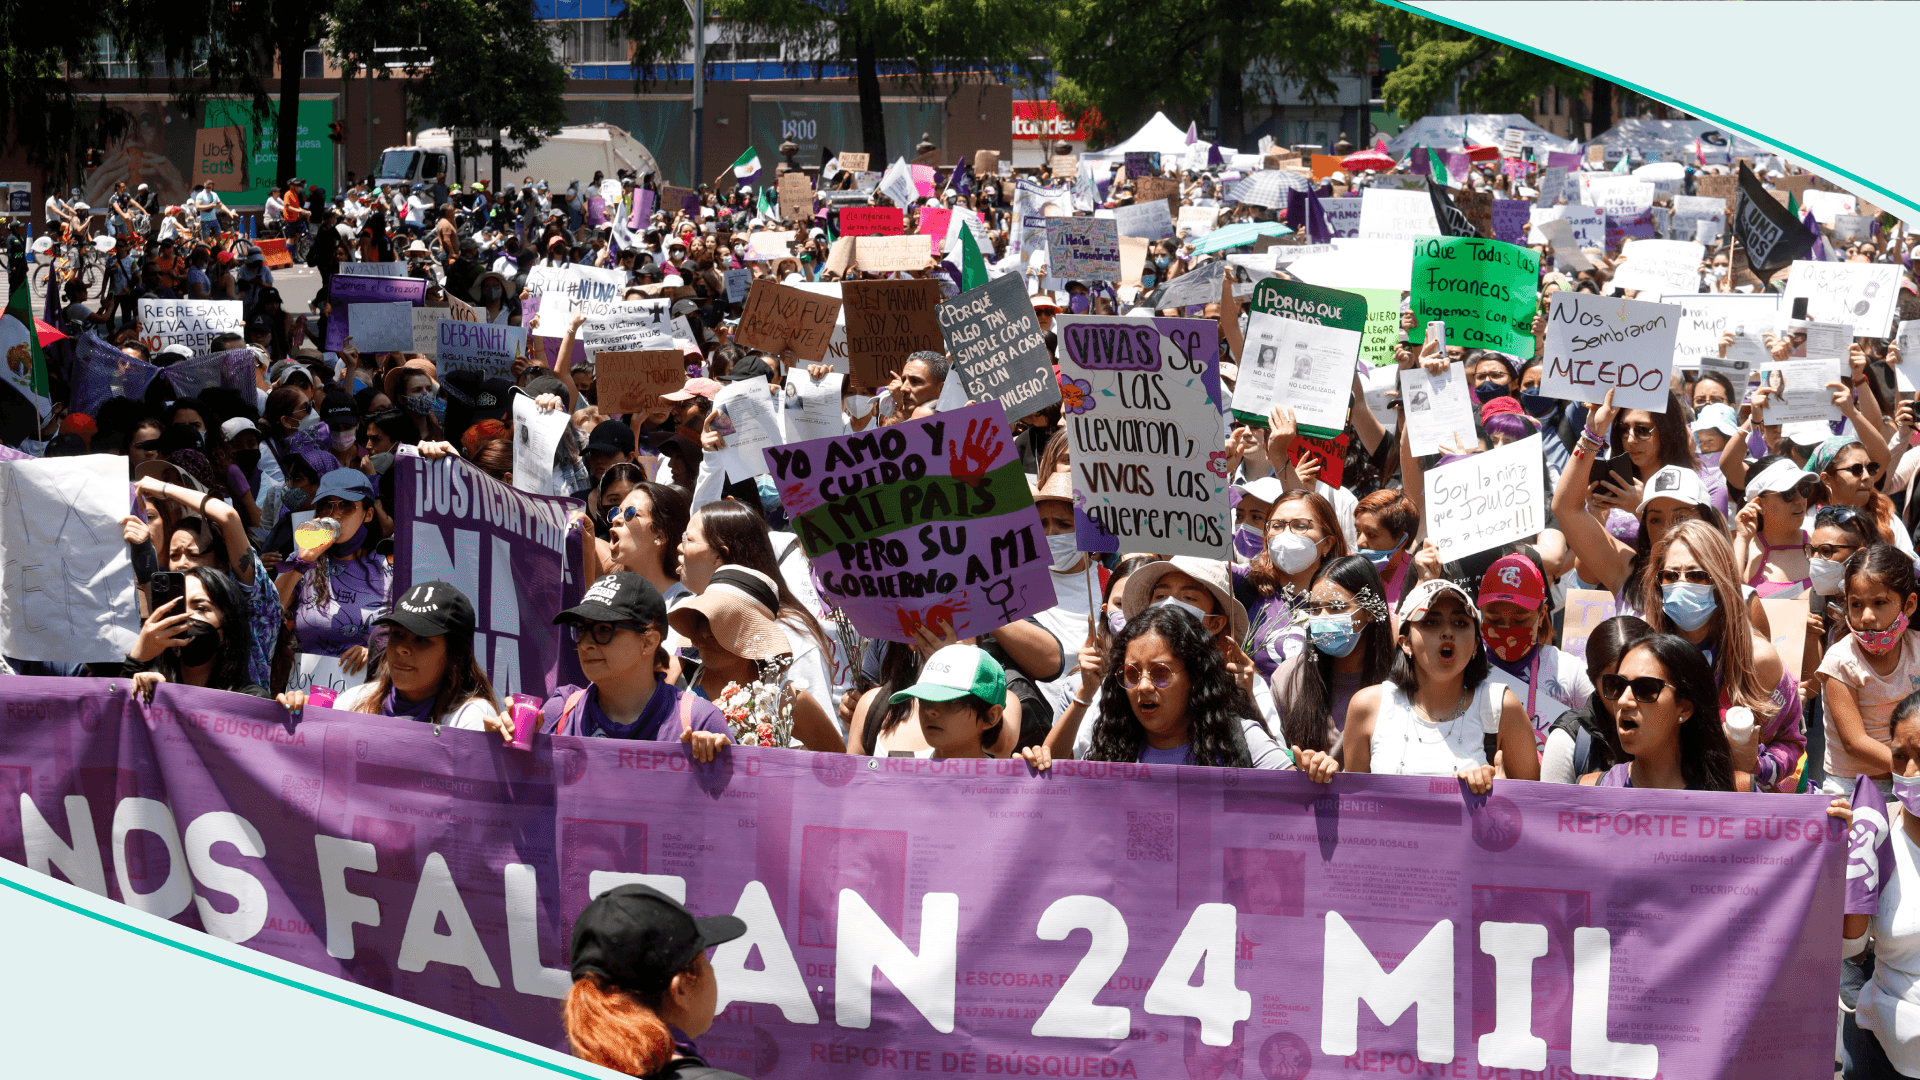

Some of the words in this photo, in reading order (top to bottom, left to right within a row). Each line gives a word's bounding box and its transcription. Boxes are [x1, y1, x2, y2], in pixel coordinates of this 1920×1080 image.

[463, 128, 490, 138] SEVILLA
[782, 119, 817, 140] 1800
[202, 142, 238, 157] Uber
[202, 159, 234, 175] Eats
[1465, 242, 1511, 266] Todas
[1427, 267, 1510, 302] Foraneas
[144, 304, 229, 319] REGRESAR
[569, 299, 610, 317] MENOS
[800, 301, 838, 325] FUE
[982, 308, 1007, 331] TAN
[1316, 303, 1344, 320] QUE
[1553, 298, 1604, 328] Nos
[143, 320, 188, 334] VIVA
[192, 320, 203, 332] A
[204, 318, 243, 333] CASA
[745, 314, 826, 352] ACCIDENTE!
[863, 313, 886, 336] SOY
[1511, 314, 1532, 332] bien
[1571, 316, 1667, 353] sembraron
[141, 335, 162, 352] NO
[441, 322, 508, 352] DEBANHI
[601, 333, 637, 344] NUESTRAS
[639, 329, 661, 340] HIJAS
[951, 324, 981, 347] ALGO
[957, 334, 1000, 365] SIMPLE
[1000, 315, 1031, 343] CÓMO
[1070, 328, 1155, 366] VIVAS
[1371, 336, 1387, 346] CON
[964, 350, 1009, 378] VOLVER
[1008, 346, 1019, 360] A
[1018, 333, 1046, 354] CASA
[1364, 345, 1387, 354] BIEN
[968, 378, 986, 396] ES
[987, 366, 1010, 387] UN
[1253, 369, 1262, 377] NO
[1549, 356, 1663, 392] MIEDO
[1117, 371, 1171, 411] las
[1298, 383, 1337, 395] LOCALIZADA
[1074, 416, 1194, 459] llevaron,
[768, 445, 812, 482] YO
[825, 428, 907, 473] AMO
[921, 421, 945, 456] Y
[819, 453, 928, 503] CUIDO
[1166, 465, 1210, 503] las
[1433, 474, 1470, 506] Soy
[1478, 465, 1491, 490] la
[1496, 462, 1528, 483] niña
[799, 513, 834, 555] A
[827, 488, 896, 541] MI
[899, 477, 997, 526] PAIS
[1086, 505, 1223, 547] queremos
[1433, 508, 1454, 528] que
[836, 537, 909, 573] PERO
[918, 524, 967, 563] SU
[1462, 532, 1470, 541] a
[823, 569, 959, 600] GOBIERNO
[965, 553, 990, 587] A
[990, 523, 1041, 577] MI
[213, 714, 307, 748] BÚSQUEDA
[884, 757, 989, 777] REPORTE
[995, 760, 1024, 778] DE
[1557, 810, 1688, 840] REPORTE
[1697, 816, 1734, 841] DE
[1268, 832, 1294, 843] DALIA
[1295, 833, 1332, 845] XIMENA
[1332, 835, 1378, 847] ALVARADO
[1378, 838, 1419, 850] ROSALES
[1652, 850, 1717, 867] ¡Ayúdanos
[1720, 856, 1727, 864] a
[1730, 853, 1794, 867] localizarle!
[1690, 884, 1759, 898] DESCRIPCIÓN
[19, 790, 269, 945] NOS
[1030, 894, 1252, 1047] 24
[1320, 909, 1659, 1080] MIL
[965, 969, 1054, 988] ESCOBAR
[810, 1042, 943, 1075] REPORTE
[947, 1051, 977, 1076] DE
[984, 1050, 1138, 1080] BÚSQUEDA
